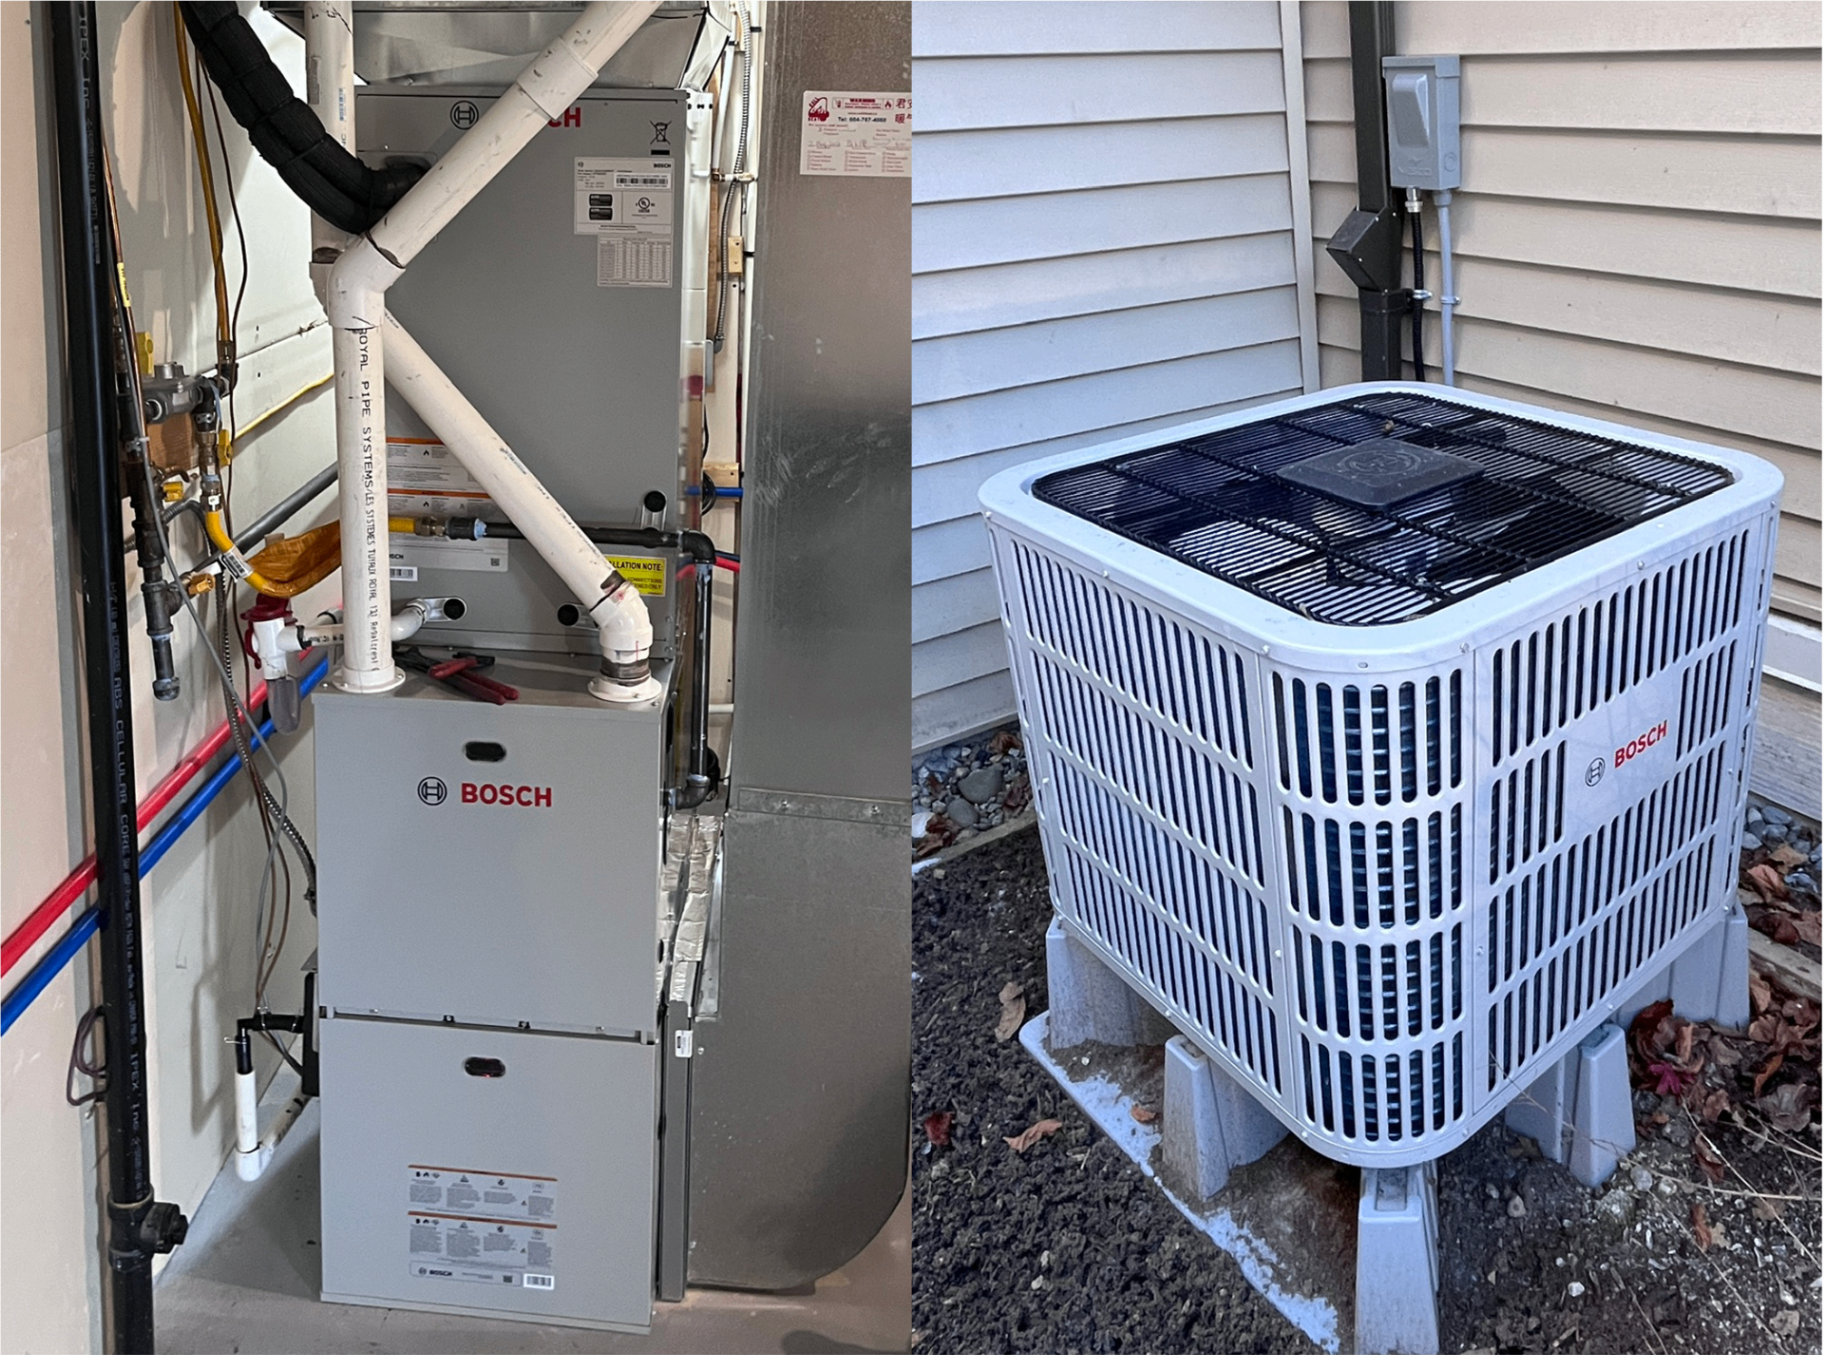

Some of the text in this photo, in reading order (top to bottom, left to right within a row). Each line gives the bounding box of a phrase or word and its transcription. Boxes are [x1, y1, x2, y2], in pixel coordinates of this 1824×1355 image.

[79, 15, 89, 60] IPEX
[358, 329, 369, 371] ROYAL
[361, 381, 371, 417] PIPE
[609, 561, 641, 569] LLATION
[114, 677, 122, 709] ABS
[116, 720, 128, 804] CELLULAR
[1614, 719, 1667, 769] BOSCH
[461, 783, 552, 807] BOSCH
[121, 814, 131, 855] CORE
[130, 1053, 140, 1091] IPEX
